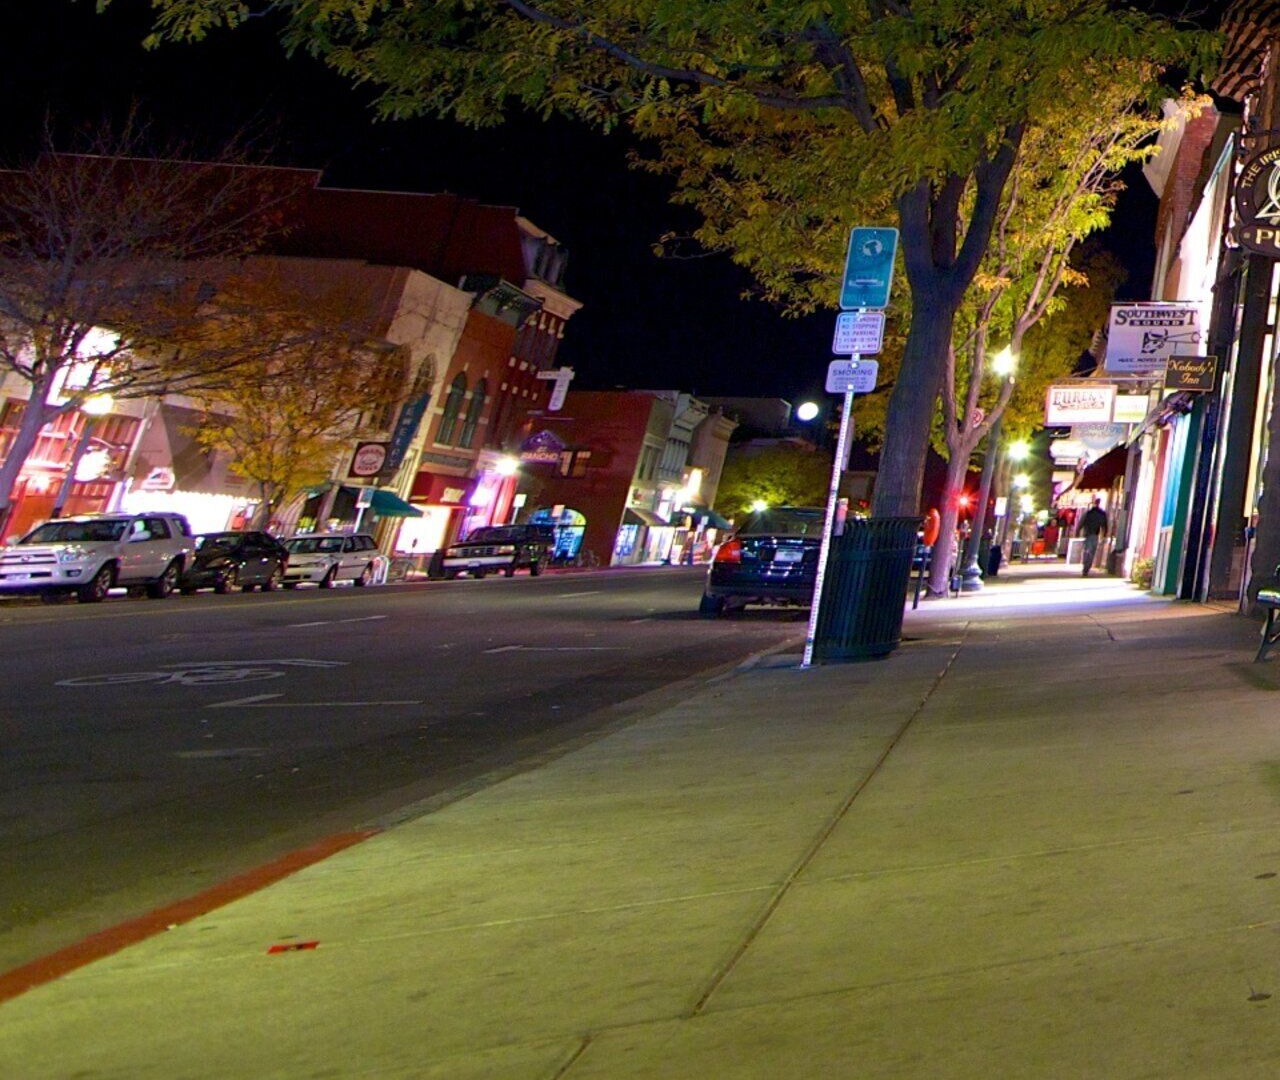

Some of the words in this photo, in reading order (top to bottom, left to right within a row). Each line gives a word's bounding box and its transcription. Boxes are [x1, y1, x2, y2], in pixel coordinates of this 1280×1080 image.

[1241, 163, 1261, 188] THE
[1114, 309, 1198, 326] SOUTHWEST
[1169, 360, 1214, 376] Nobody's
[1181, 373, 1200, 384] Inn
